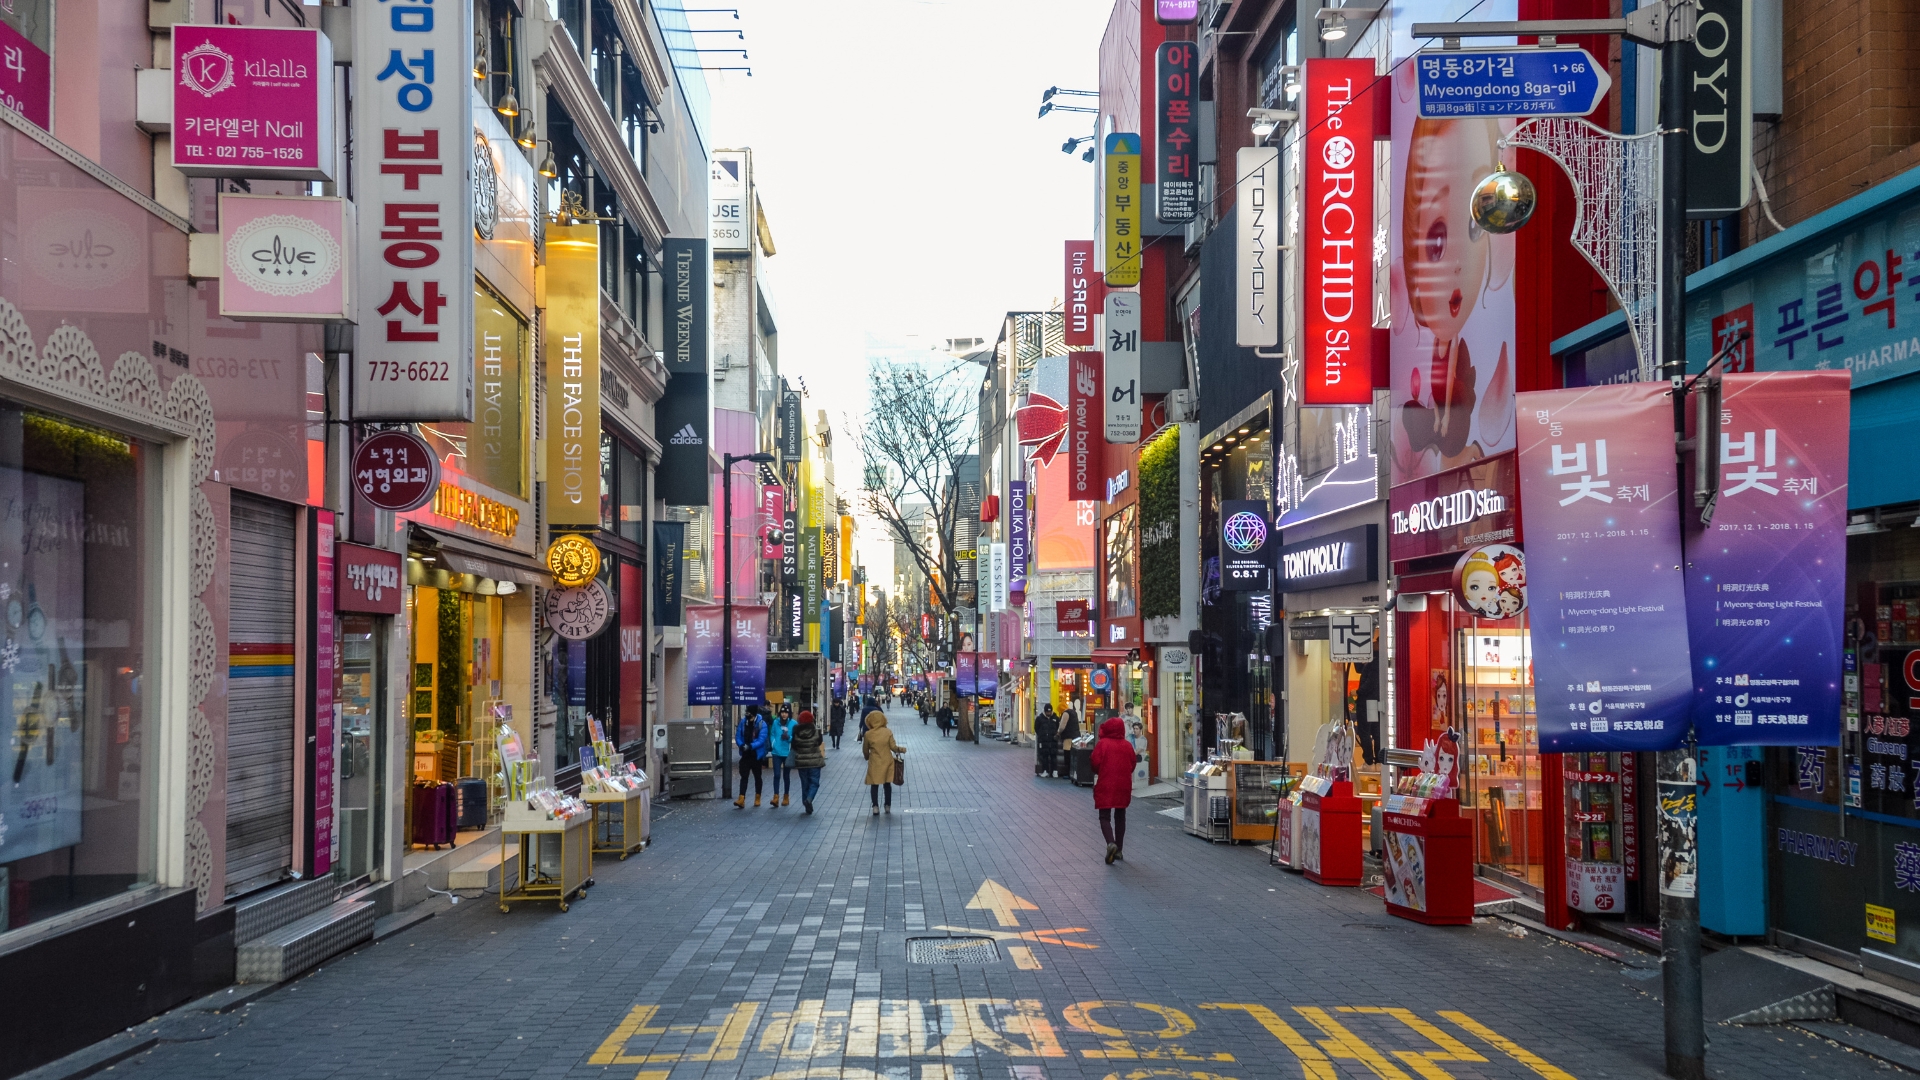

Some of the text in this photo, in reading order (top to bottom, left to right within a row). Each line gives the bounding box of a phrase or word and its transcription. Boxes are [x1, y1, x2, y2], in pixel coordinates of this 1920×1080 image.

[1160, 1, 1195, 9] 774-8917
[244, 58, 308, 79] kilalla
[1422, 57, 1515, 79] 명동8가길
[1693, 0, 1729, 154] OYD
[1424, 80, 1576, 98] Myeongdong 8ga-gil
[1166, 45, 1192, 178] 아이폰수리
[185, 117, 303, 138] 키라엘라 Nail
[185, 145, 204, 157] TEL
[241, 146, 303, 160] 755-1526
[379, 127, 446, 343] 부동산
[1252, 167, 1265, 325] TONYMOLY
[1322, 77, 1355, 386] The ORCHID Skin
[252, 235, 316, 265] clue
[1073, 252, 1086, 274] the
[677, 249, 693, 363] TEENIE WEENIE
[368, 361, 449, 381] 773-6622
[1109, 329, 1137, 405] 헤어
[563, 332, 582, 504] THE FACE SHOP
[1077, 398, 1087, 428] new
[670, 436, 703, 445] adidas
[370, 447, 408, 466] 노정식
[1076, 431, 1087, 491] balance
[1720, 429, 1818, 498] 빛 축제
[358, 467, 428, 493] 성형외과
[1551, 439, 1649, 507] 빛 축제
[1392, 488, 1505, 534] The ORCHID Skin
[783, 519, 795, 575] GUESS
[1012, 489, 1024, 582] HOLIKA HOLIKA
[1640, 528, 1649, 536] 15
[552, 540, 593, 575] THE FACE SHOP
[808, 535, 816, 615] NATURE REPUBLIC
[793, 594, 801, 637] ARITAUM
[1568, 604, 1665, 616] Myeong-dong Light Festival
[1723, 600, 1823, 610] Myeong-dong Light Festival
[559, 622, 593, 636] CAFE
[694, 620, 710, 638] 빛
[736, 620, 752, 638] 빛
[622, 629, 641, 663] SALE
[1867, 737, 1907, 760] Ginseng
[1726, 765, 1742, 776] 1F
[1778, 828, 1858, 867] PHARMACY
[1597, 896, 1612, 908] 2F
